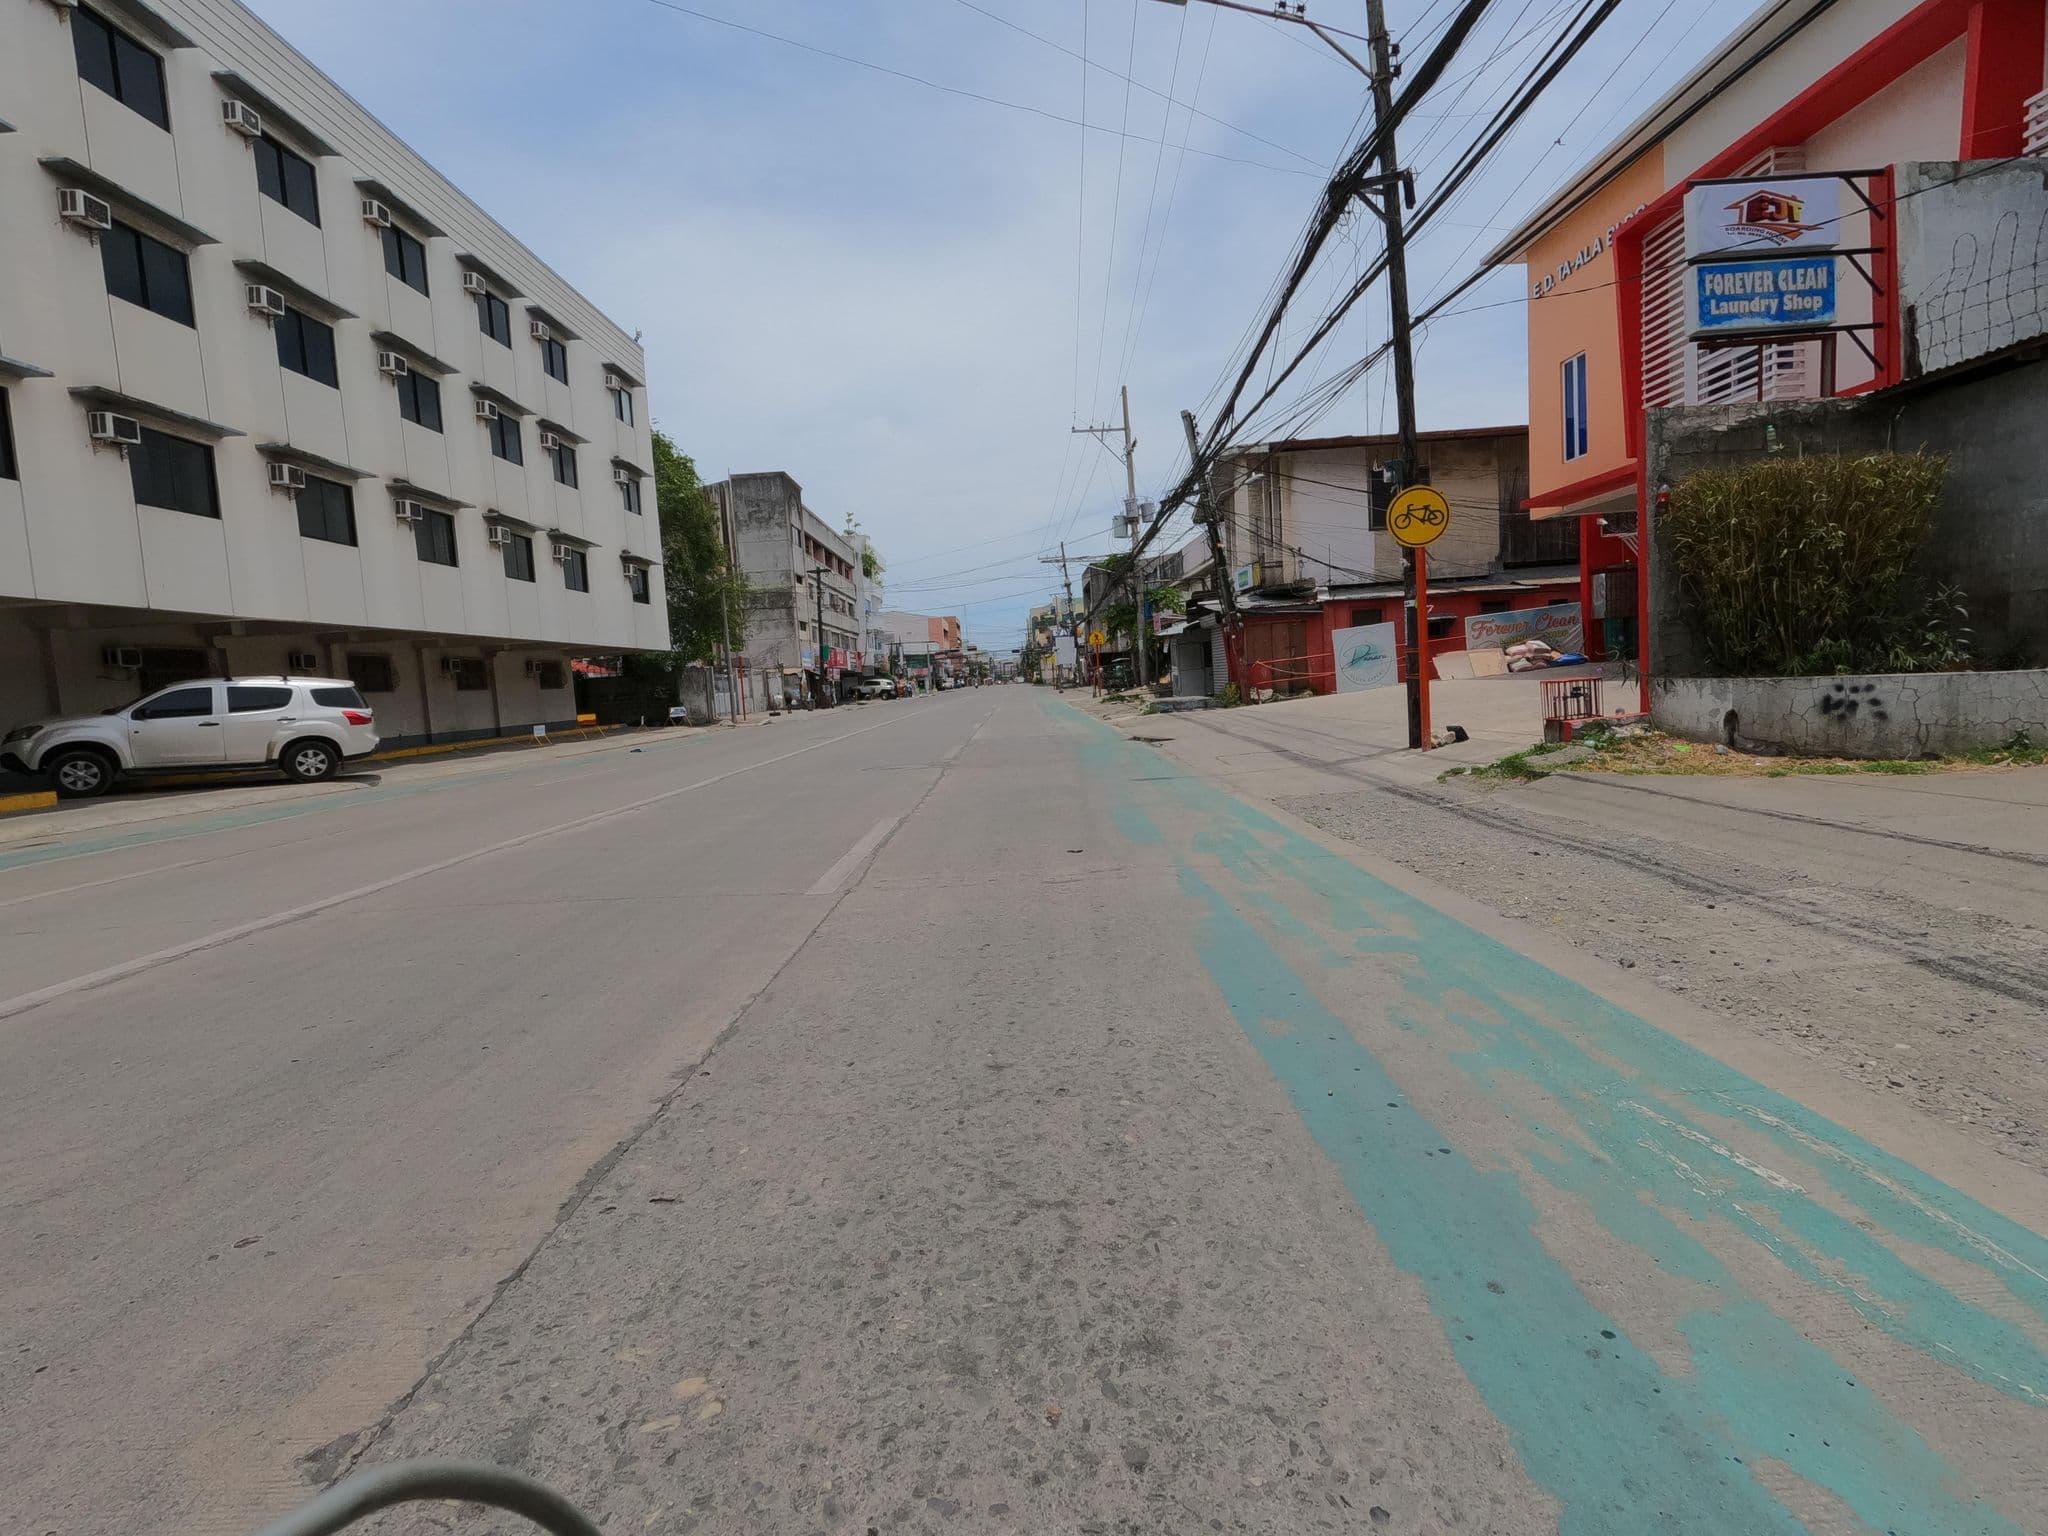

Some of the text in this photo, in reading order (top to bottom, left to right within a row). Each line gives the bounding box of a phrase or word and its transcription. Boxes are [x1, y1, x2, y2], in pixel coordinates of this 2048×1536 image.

[1557, 237, 1604, 281] TA-ALA
[1705, 266, 1828, 296] FOREVER CLEAN
[1710, 294, 1823, 315] Laundry Shop
